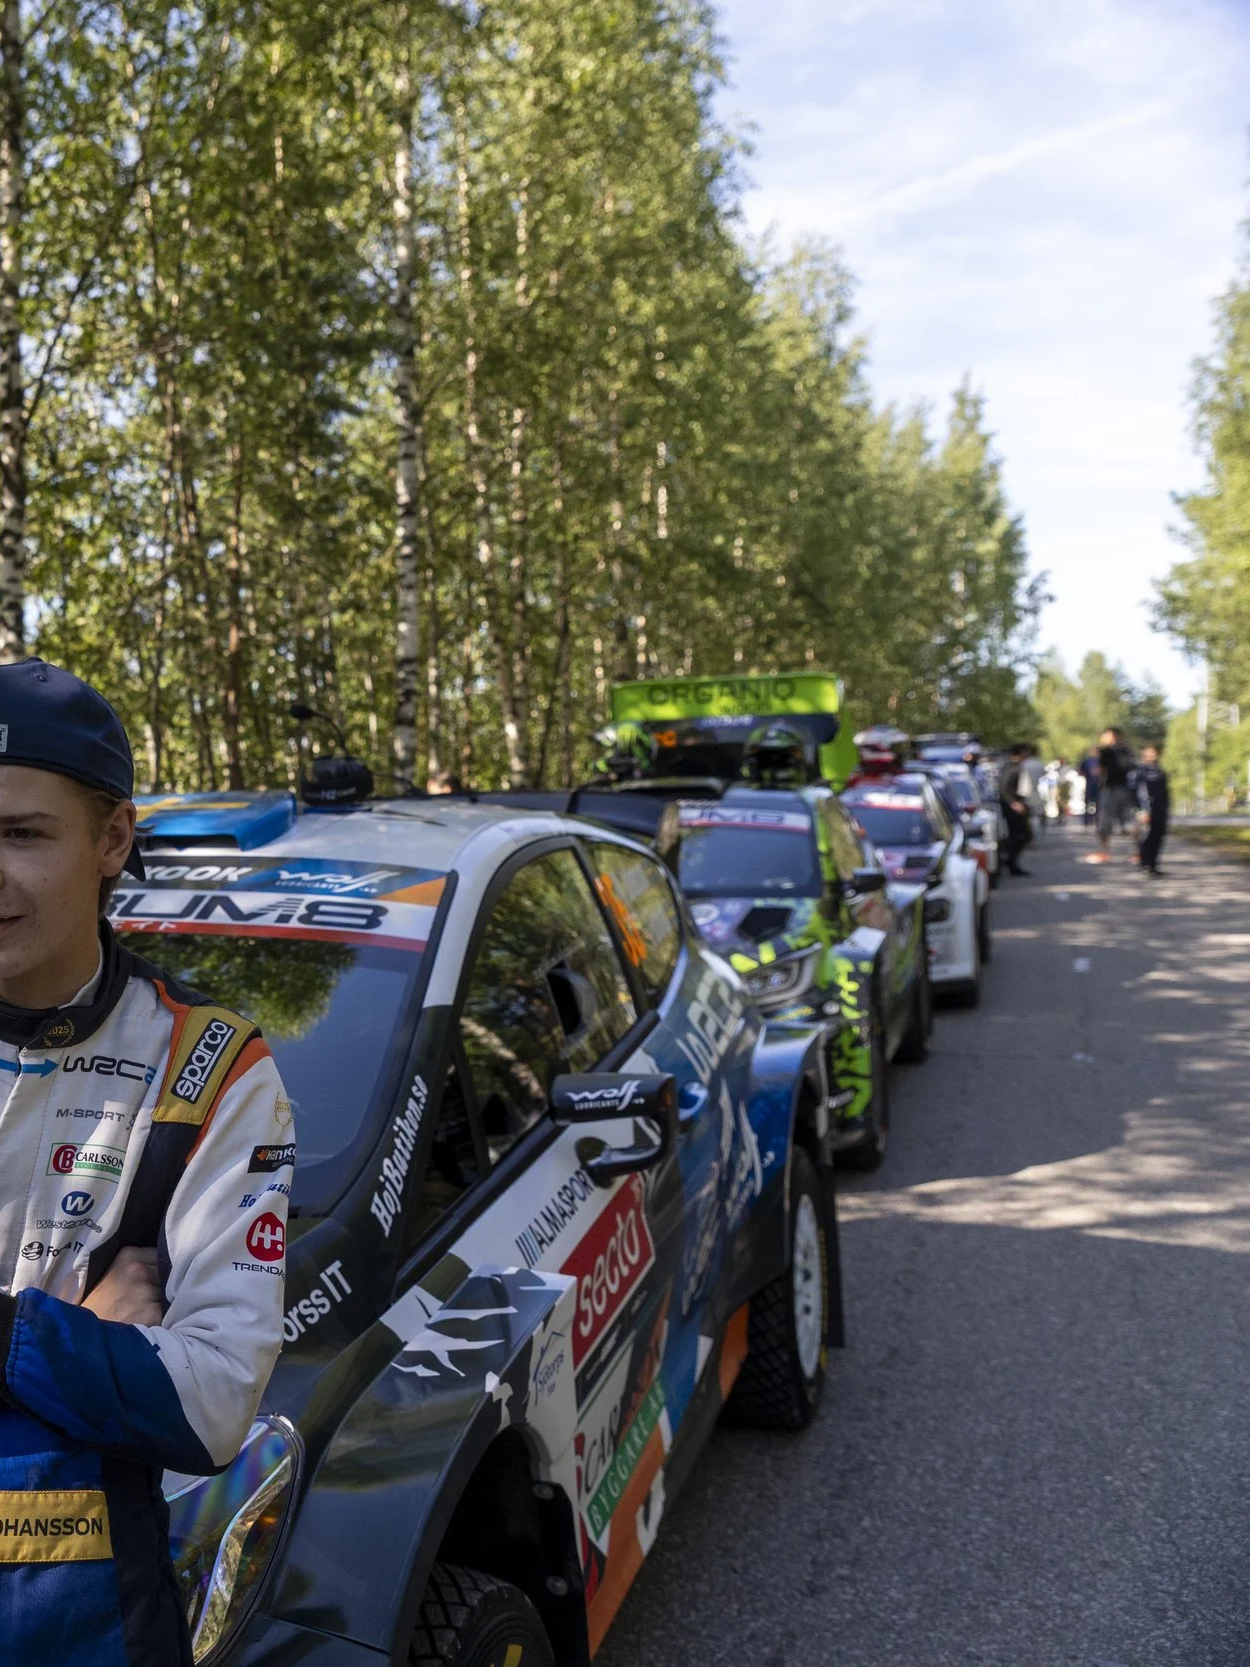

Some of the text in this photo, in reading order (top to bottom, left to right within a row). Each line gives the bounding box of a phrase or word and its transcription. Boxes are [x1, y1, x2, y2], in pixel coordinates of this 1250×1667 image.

[175, 1021, 237, 1103] sparco
[56, 1108, 125, 1122] M-SPORT
[567, 1080, 641, 1111] wolf
[319, 1260, 352, 1303] IT
[579, 1209, 640, 1337] secto
